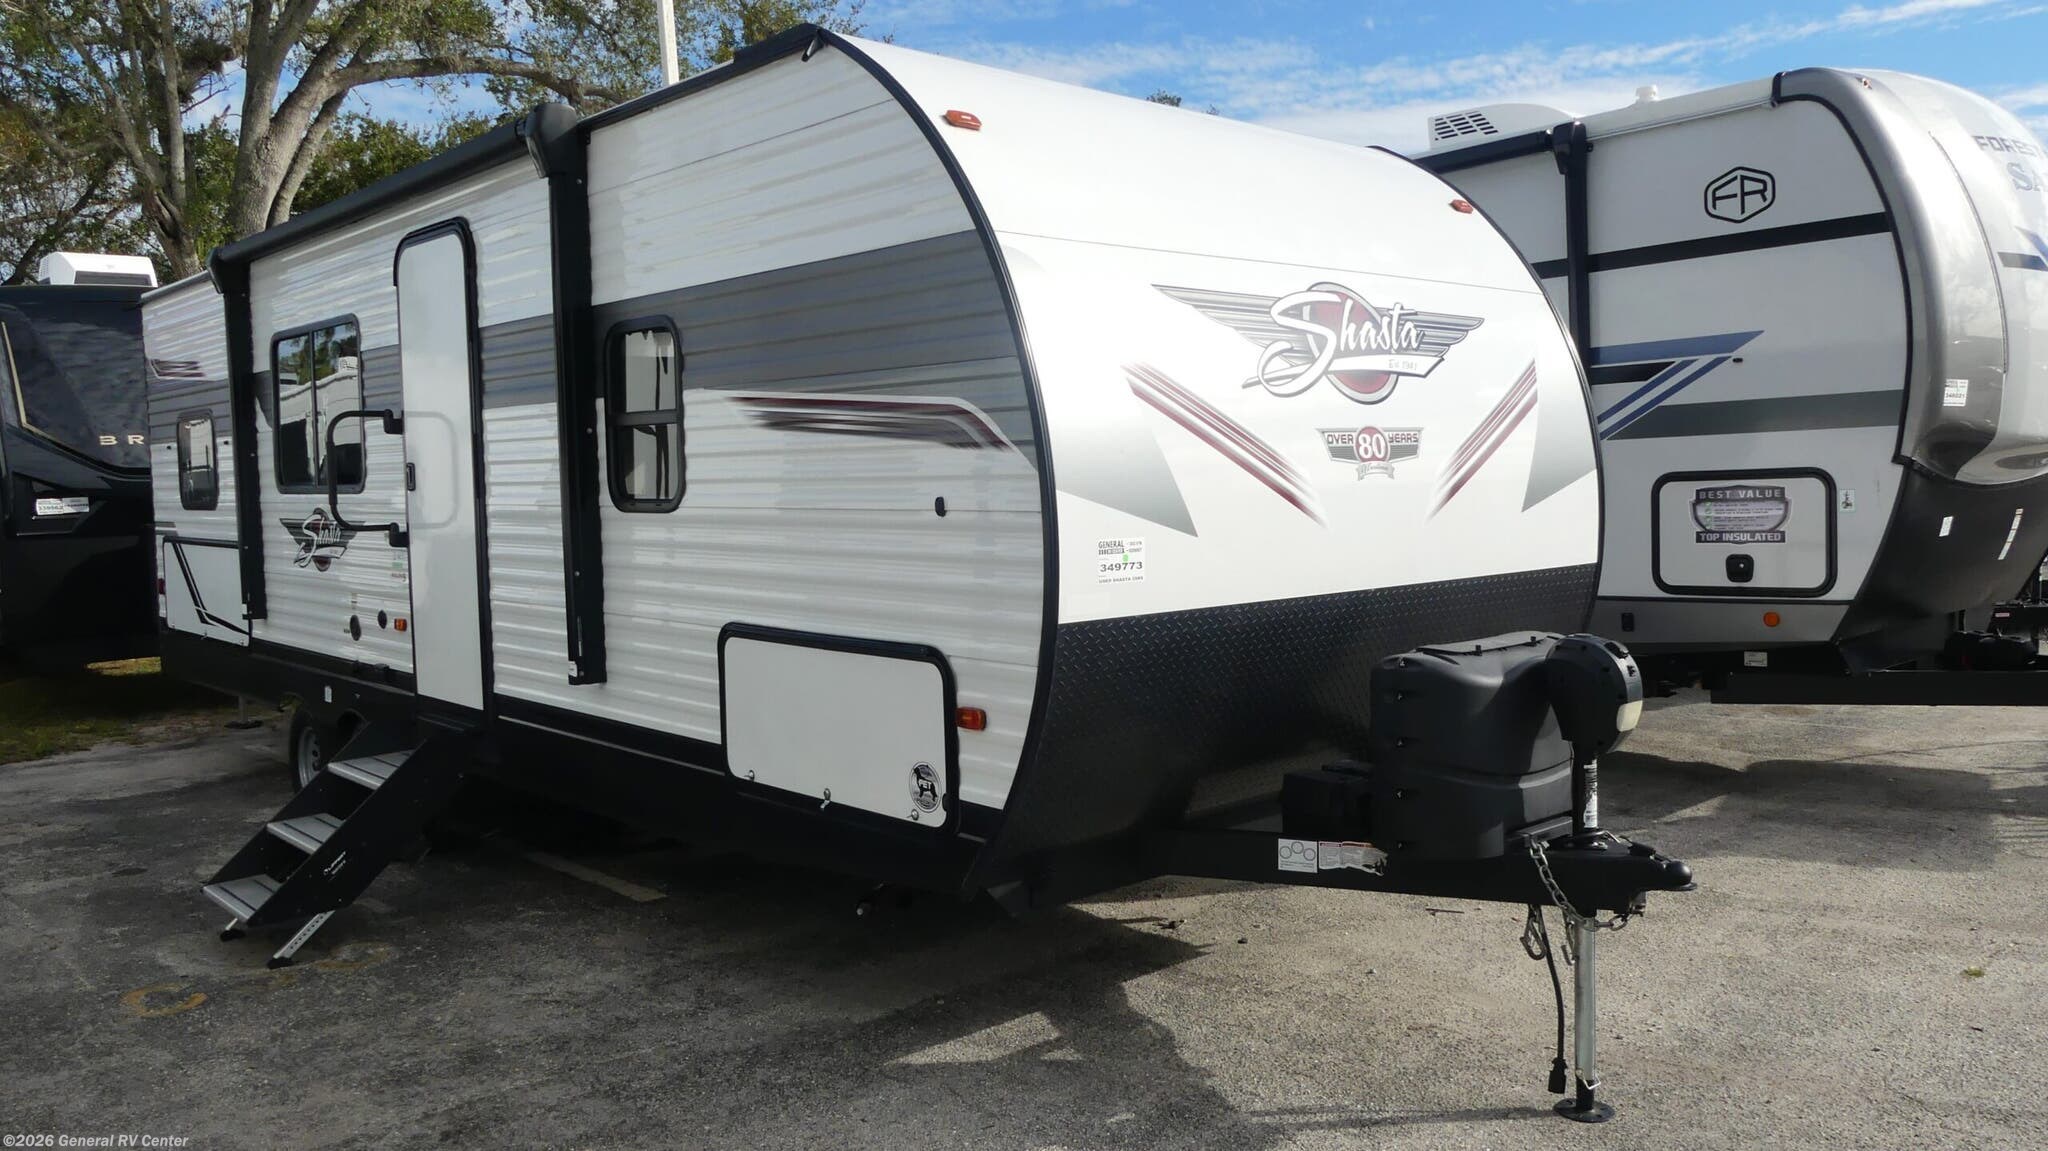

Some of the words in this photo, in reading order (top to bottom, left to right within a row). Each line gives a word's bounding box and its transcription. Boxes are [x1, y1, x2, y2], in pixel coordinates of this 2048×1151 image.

[1257, 290, 1426, 398] Shasta
[1326, 433, 1354, 444] OVER
[1358, 433, 1386, 459] 80
[1387, 433, 1419, 444] YEARS
[1699, 490, 1731, 499] BEST
[1738, 489, 1782, 499] VALUE
[1700, 532, 1720, 542] TOP
[1722, 532, 1782, 541] INSULATED
[1098, 540, 1125, 549] GENERAL
[1100, 561, 1143, 572] 349773
